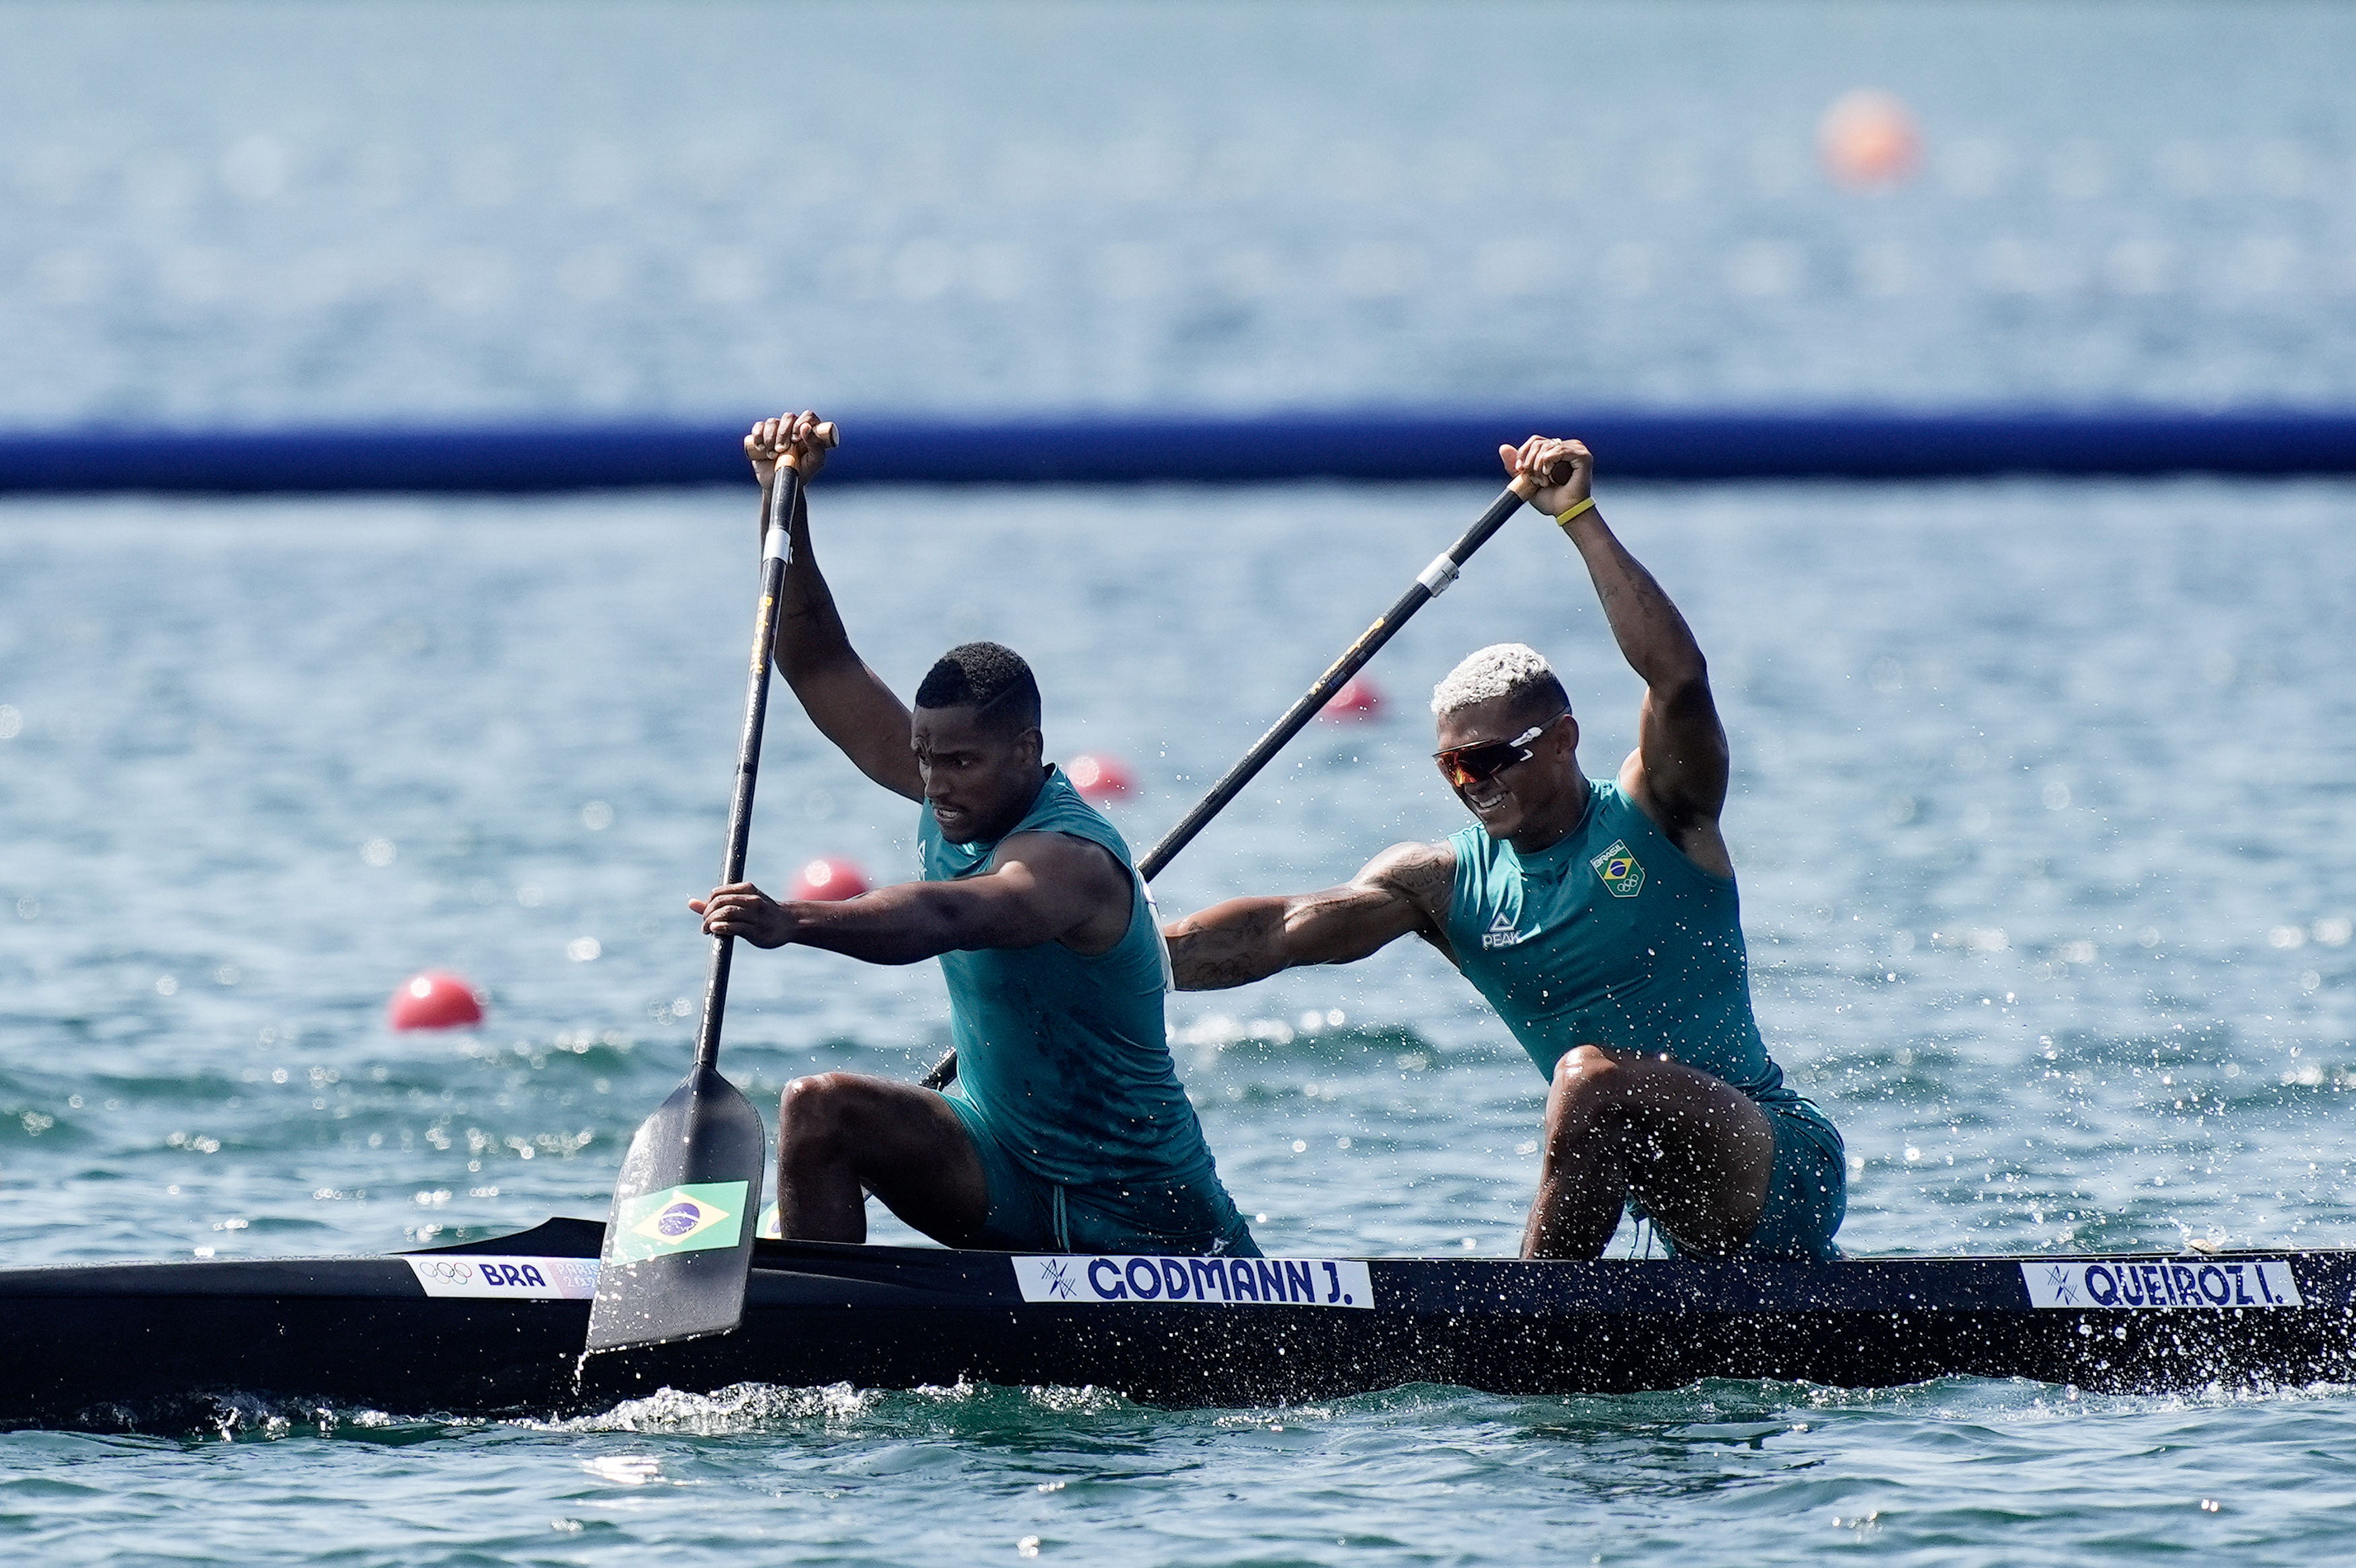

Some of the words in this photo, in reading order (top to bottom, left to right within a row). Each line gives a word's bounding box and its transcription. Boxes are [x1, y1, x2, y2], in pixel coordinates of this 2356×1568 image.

[1593, 844, 1624, 868] BRASIL
[1482, 929, 1523, 948] PEAK
[479, 1264, 547, 1287] BRA
[563, 1276, 596, 1287] 202
[1087, 1258, 1315, 1303] GODMANN
[1323, 1262, 1353, 1306] J.
[2085, 1264, 2255, 1306] QUEIROZ
[2255, 1264, 2285, 1304] I.
